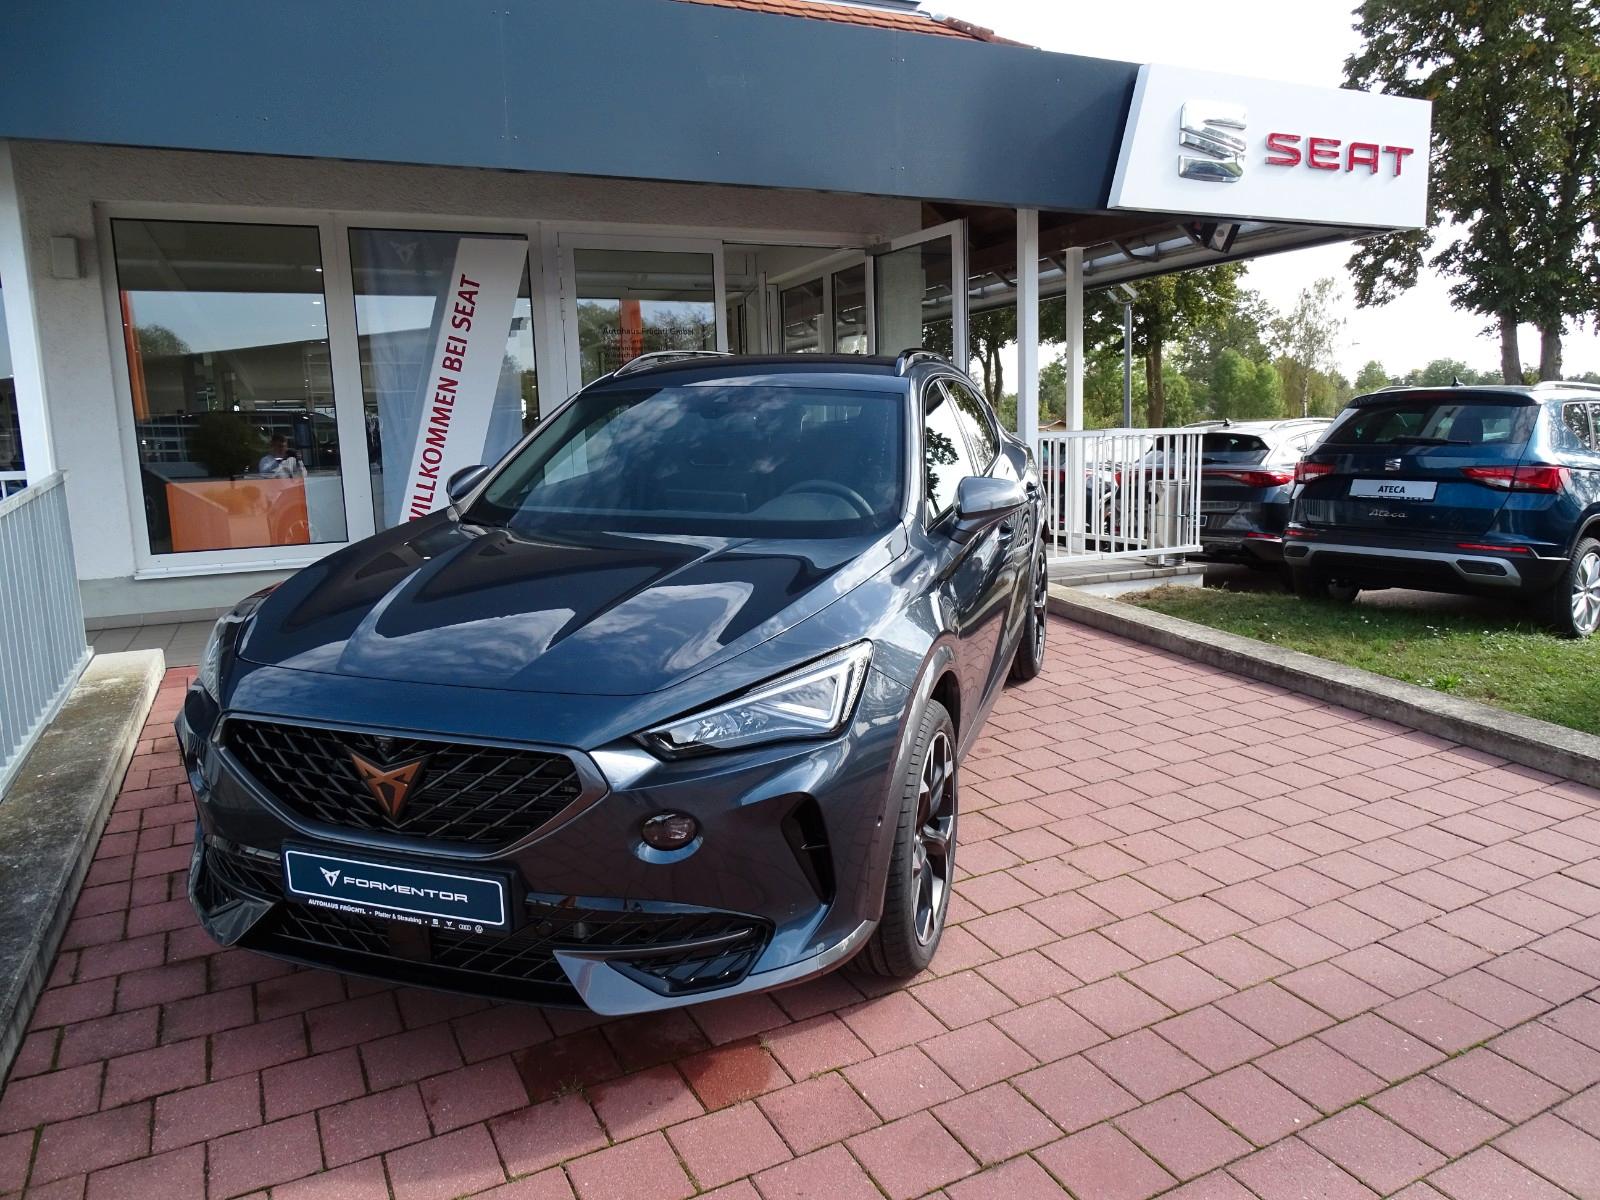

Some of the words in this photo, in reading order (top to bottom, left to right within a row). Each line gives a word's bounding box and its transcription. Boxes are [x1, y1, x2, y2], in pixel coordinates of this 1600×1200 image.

[1265, 132, 1414, 177] SEAT
[451, 273, 481, 332] SEAT
[442, 335, 468, 372] BEI
[1377, 485, 1405, 494] ATECA
[1368, 508, 1408, 518] Ateca
[343, 876, 468, 903] FORMENTOR
[308, 898, 339, 910] AUTOHAUS
